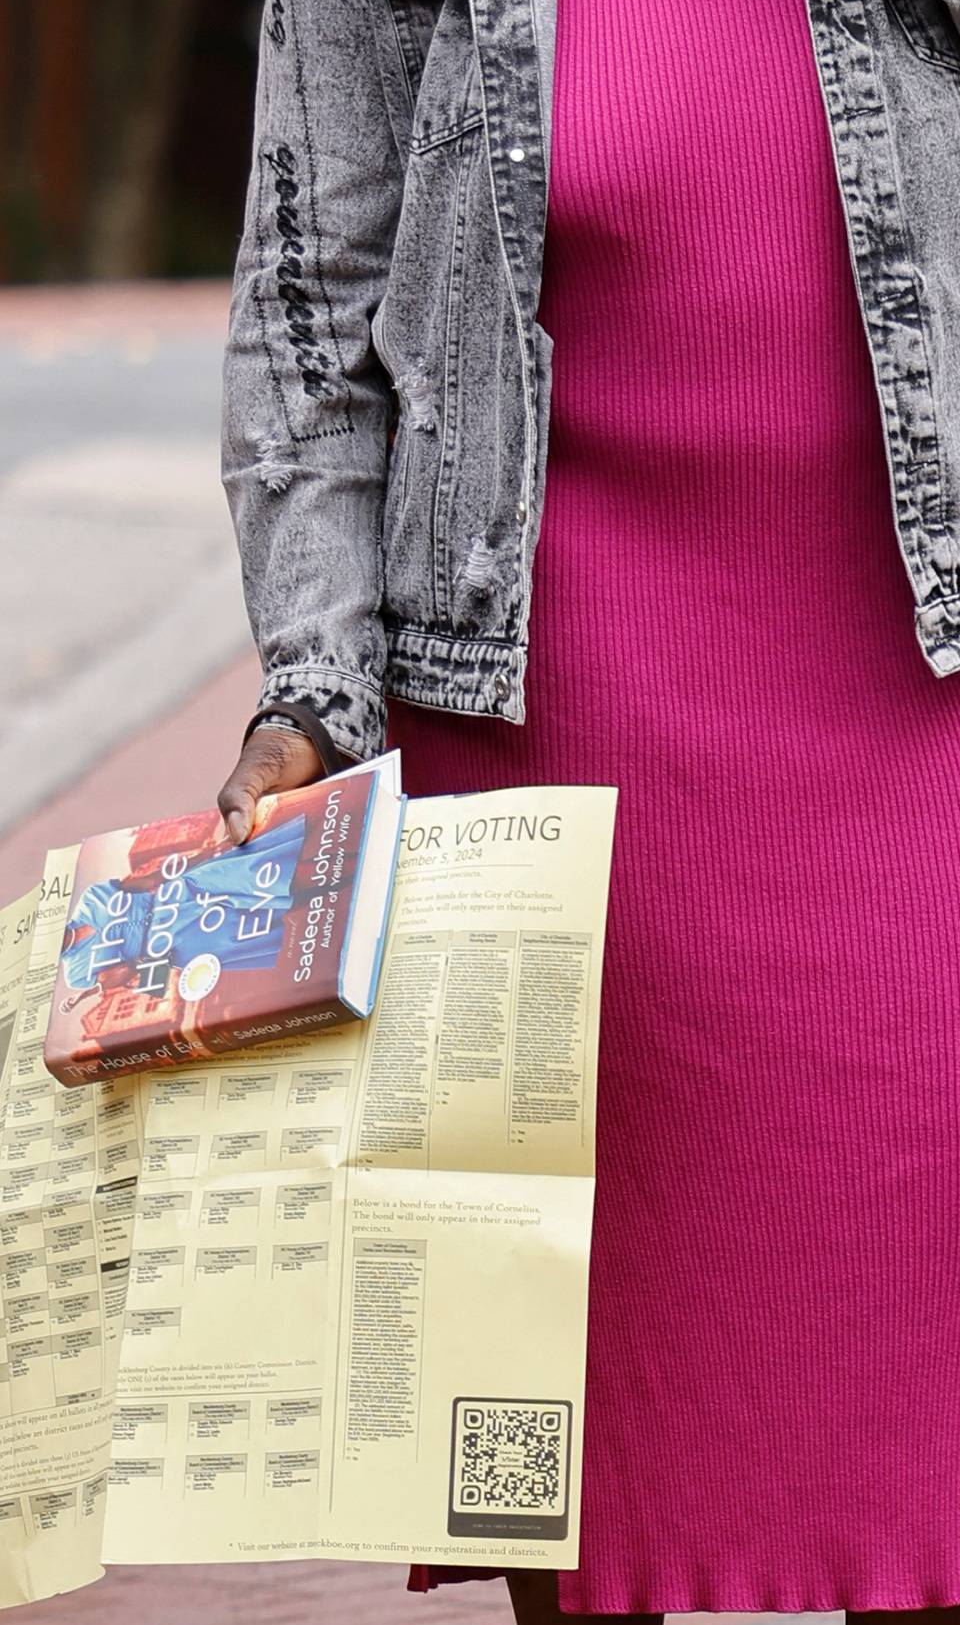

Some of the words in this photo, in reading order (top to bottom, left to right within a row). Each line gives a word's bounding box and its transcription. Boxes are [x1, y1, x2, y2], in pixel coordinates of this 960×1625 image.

[338, 813, 352, 843] Wife
[400, 825, 443, 852] FOR
[454, 815, 562, 846] VOTING
[330, 848, 346, 887] Yellow
[396, 853, 436, 870] vember
[237, 861, 280, 941] Eve
[294, 894, 324, 984] Sadeqa
[311, 790, 342, 887] Johnson
[329, 890, 338, 904] of
[133, 853, 188, 994] House
[196, 891, 228, 932] of
[321, 908, 336, 949] Author
[87, 889, 132, 982] The
[64, 1060, 98, 1077] The
[100, 1051, 151, 1072] House
[156, 1044, 172, 1058] of
[174, 1039, 204, 1056] Eve
[234, 1022, 282, 1040] Sadeqa
[284, 1010, 336, 1032] Johnson
[353, 1211, 370, 1220] The
[373, 1212, 394, 1220] bond
[397, 1212, 414, 1222] will
[416, 1214, 435, 1224] only
[438, 1215, 466, 1225] appear
[469, 1216, 478, 1224] in
[480, 1216, 502, 1224] their
[504, 1217, 541, 1227] assigned
[354, 1199, 380, 1208] Below
[400, 1200, 421, 1209] bond
[424, 1200, 436, 1210] for
[440, 1200, 452, 1210] the
[456, 1201, 482, 1212] Town
[484, 1202, 494, 1212] of
[363, 1542, 372, 1550] to
[374, 1542, 409, 1552] confirm
[412, 1544, 432, 1554] your
[434, 1545, 486, 1555] registration
[490, 1547, 506, 1556] and
[508, 1546, 548, 1557] districts.
